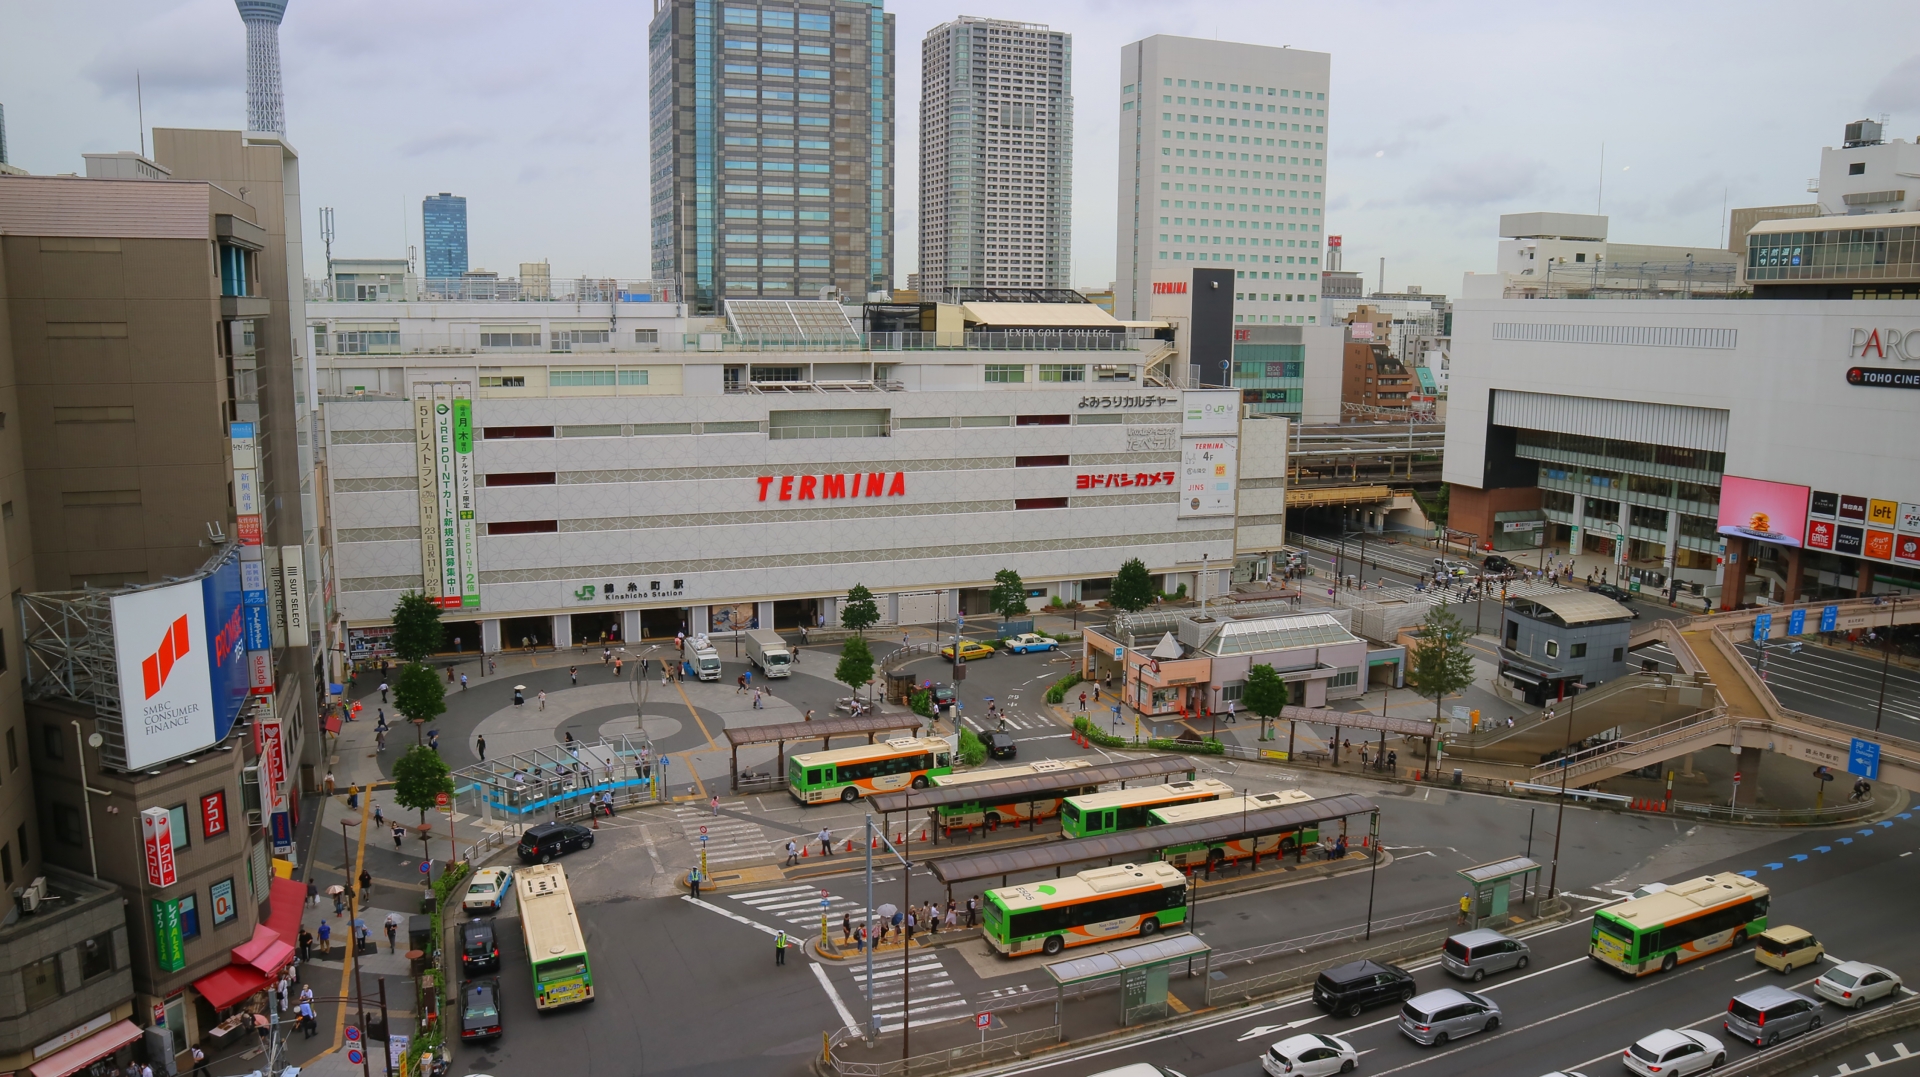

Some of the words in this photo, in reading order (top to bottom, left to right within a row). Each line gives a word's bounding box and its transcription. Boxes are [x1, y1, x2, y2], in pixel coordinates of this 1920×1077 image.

[1152, 282, 1187, 294] TERMINA
[1004, 328, 1034, 338] JEXER
[1038, 329, 1063, 338] GOLF
[1067, 329, 1111, 338] COLLEGE
[1863, 372, 1892, 383] TOHO
[1078, 395, 1178, 409] よみうりカルチャー
[1213, 405, 1225, 413] JR
[440, 417, 448, 443] JRE
[1203, 451, 1214, 461] 4F
[757, 471, 905, 502] TERMINA
[1076, 471, 1175, 489] ヨドバシカメラ
[241, 472, 252, 511] 新興商事
[290, 578, 298, 597] SUIT
[575, 585, 596, 597] JR
[604, 579, 684, 594] 錦糸町駅
[652, 590, 683, 598] Station
[291, 598, 300, 628] SELECT
[256, 656, 267, 685] salada
[143, 700, 172, 716] SMBC
[144, 703, 199, 726] CONSUMER
[145, 715, 190, 736] FINANCE
[206, 796, 221, 833] アコム
[147, 844, 160, 878] アコム
[160, 843, 173, 874] アコム
[168, 904, 178, 928] レイク
[171, 928, 181, 961] ALSA
